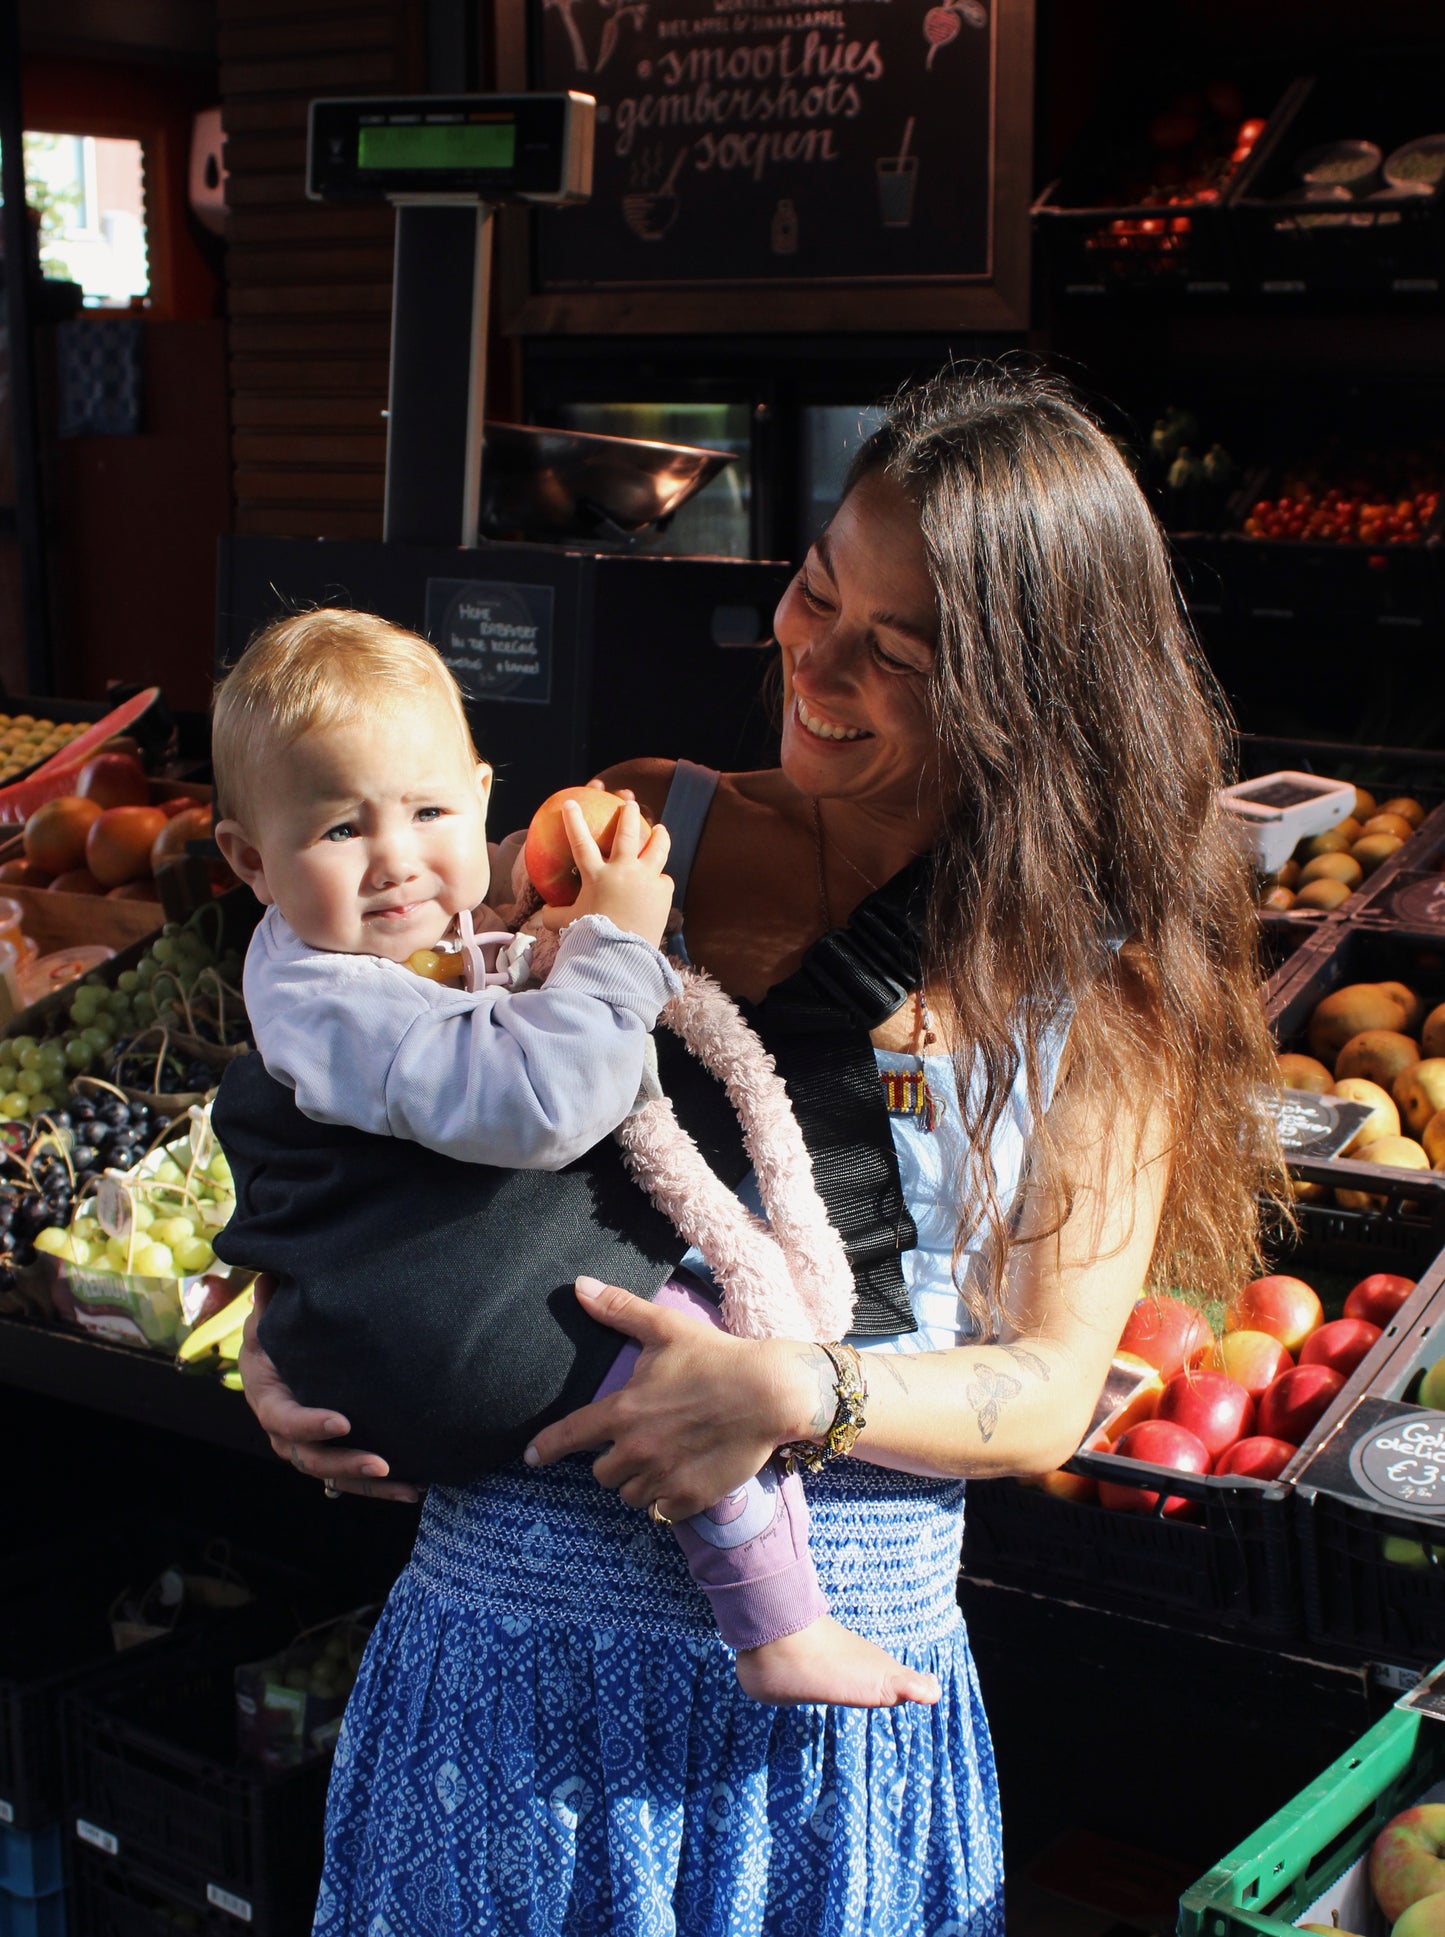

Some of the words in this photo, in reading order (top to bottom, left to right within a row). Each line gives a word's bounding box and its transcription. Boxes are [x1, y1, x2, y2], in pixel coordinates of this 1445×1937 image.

[657, 30, 883, 86] smoothies
[616, 78, 861, 155] gembershots
[694, 127, 839, 180] soepen
